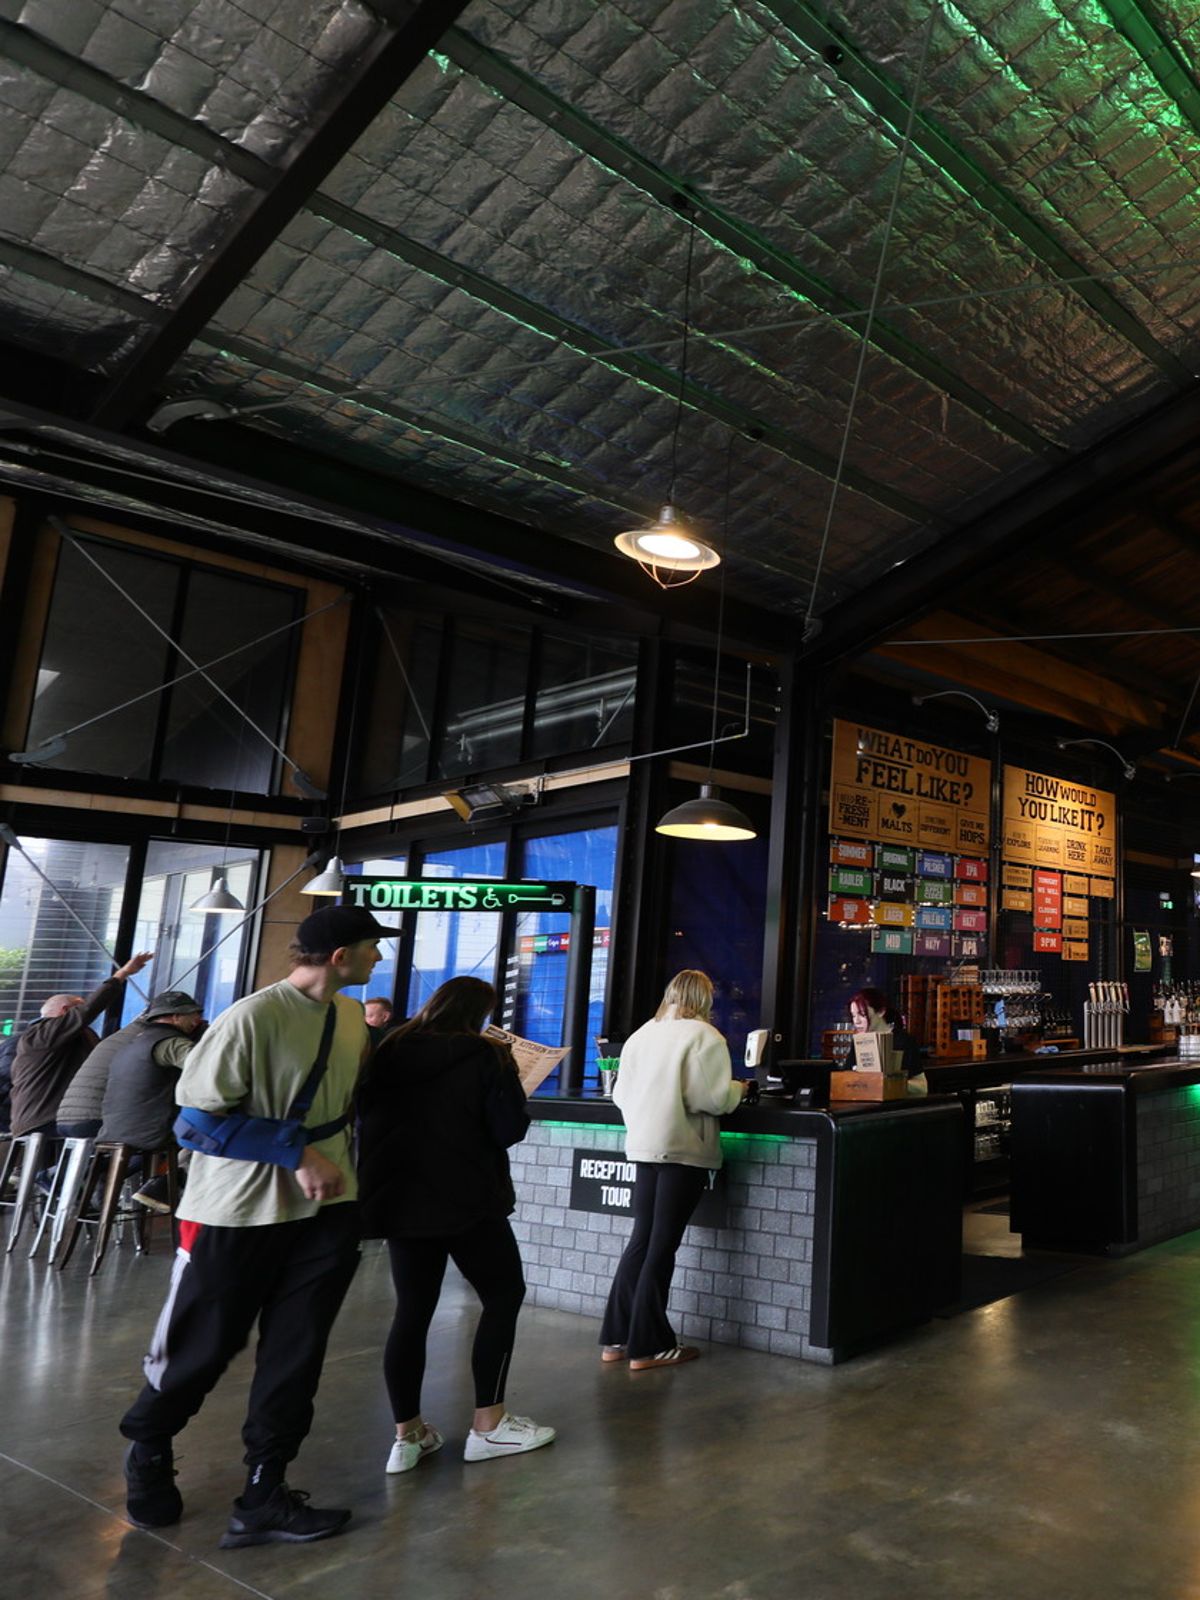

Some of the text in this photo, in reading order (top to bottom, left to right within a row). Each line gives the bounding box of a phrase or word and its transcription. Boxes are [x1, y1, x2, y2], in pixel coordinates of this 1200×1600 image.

[857, 728, 969, 778] WHAT DO YOU
[856, 758, 973, 806] FEEL LIKE?
[1025, 773, 1097, 807] HOW WOULD
[1018, 797, 1048, 821] YOU
[1050, 804, 1078, 827] LIKE
[881, 817, 913, 834] MALTS
[959, 831, 985, 845] HOPS
[1068, 850, 1086, 862] HERE
[883, 877, 906, 892] BLACK
[350, 883, 477, 909] TOILETS
[962, 940, 977, 956] APA
[1040, 936, 1057, 948] 9PM
[600, 1185, 631, 1208] TOUR
